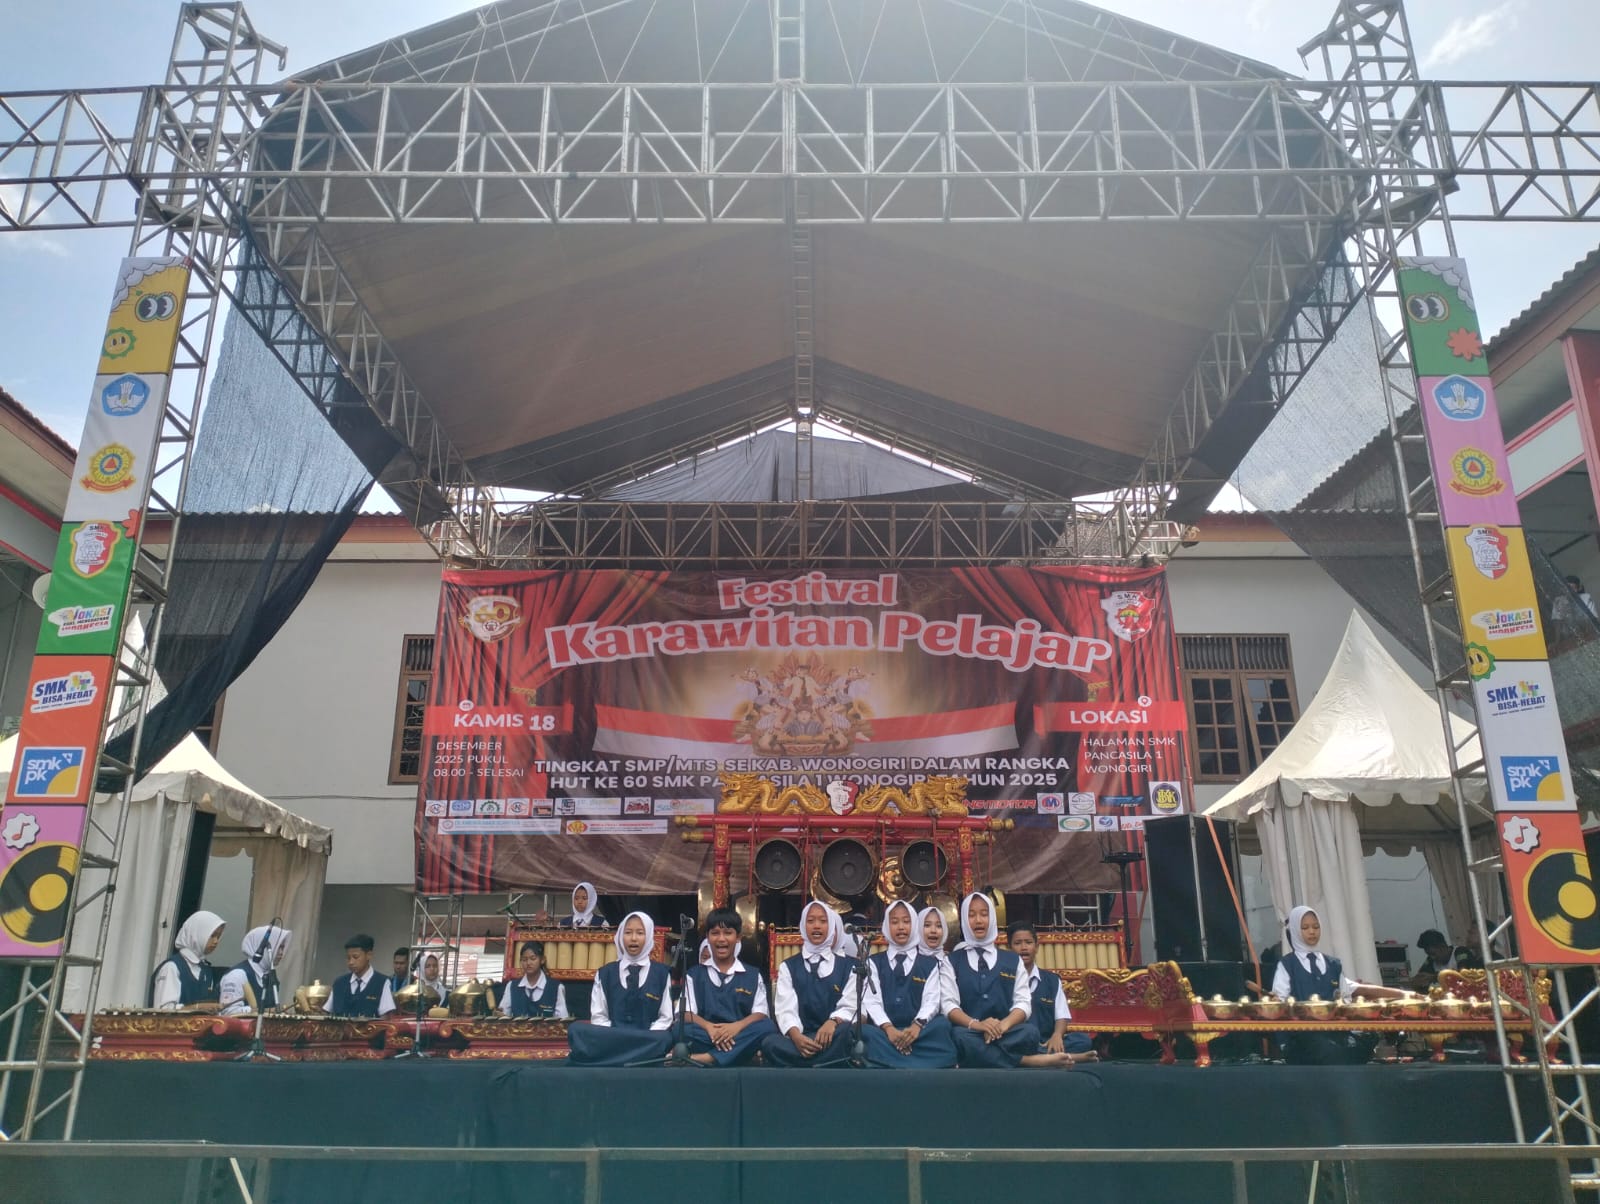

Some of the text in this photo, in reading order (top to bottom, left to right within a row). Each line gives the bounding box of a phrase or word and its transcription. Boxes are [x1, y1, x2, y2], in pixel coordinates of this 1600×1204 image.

[717, 571, 899, 609] Festival
[545, 606, 1112, 672] Karawitan Pelajar
[35, 680, 68, 697] SMK
[1487, 686, 1518, 703] SMK
[454, 713, 555, 731] KAMIS 18
[1069, 710, 1148, 724] LOKASI
[436, 742, 502, 751] DESEMBER
[1083, 737, 1177, 747] HALAMAN SMK
[27, 756, 62, 770] smk
[434, 755, 509, 764] 2025 PUKUL
[1084, 751, 1163, 760] PANCASILA 1
[534, 760, 621, 773] TINGKAT
[625, 755, 716, 774] SMP/MTS
[802, 758, 906, 771] WONOGIRI
[911, 757, 980, 770] DALAM
[985, 757, 1070, 770] RANGKA
[1084, 764, 1152, 774] WONOGIRI
[1507, 763, 1542, 776] smk
[25, 768, 48, 784] pk
[433, 768, 466, 777] 08.00
[477, 768, 524, 777] SELESAI
[551, 777, 590, 789] HUT
[594, 776, 619, 788] KE
[623, 776, 648, 788] 60
[652, 776, 695, 788] SMK
[1009, 773, 1057, 786] 2025
[1510, 775, 1532, 791] pk
